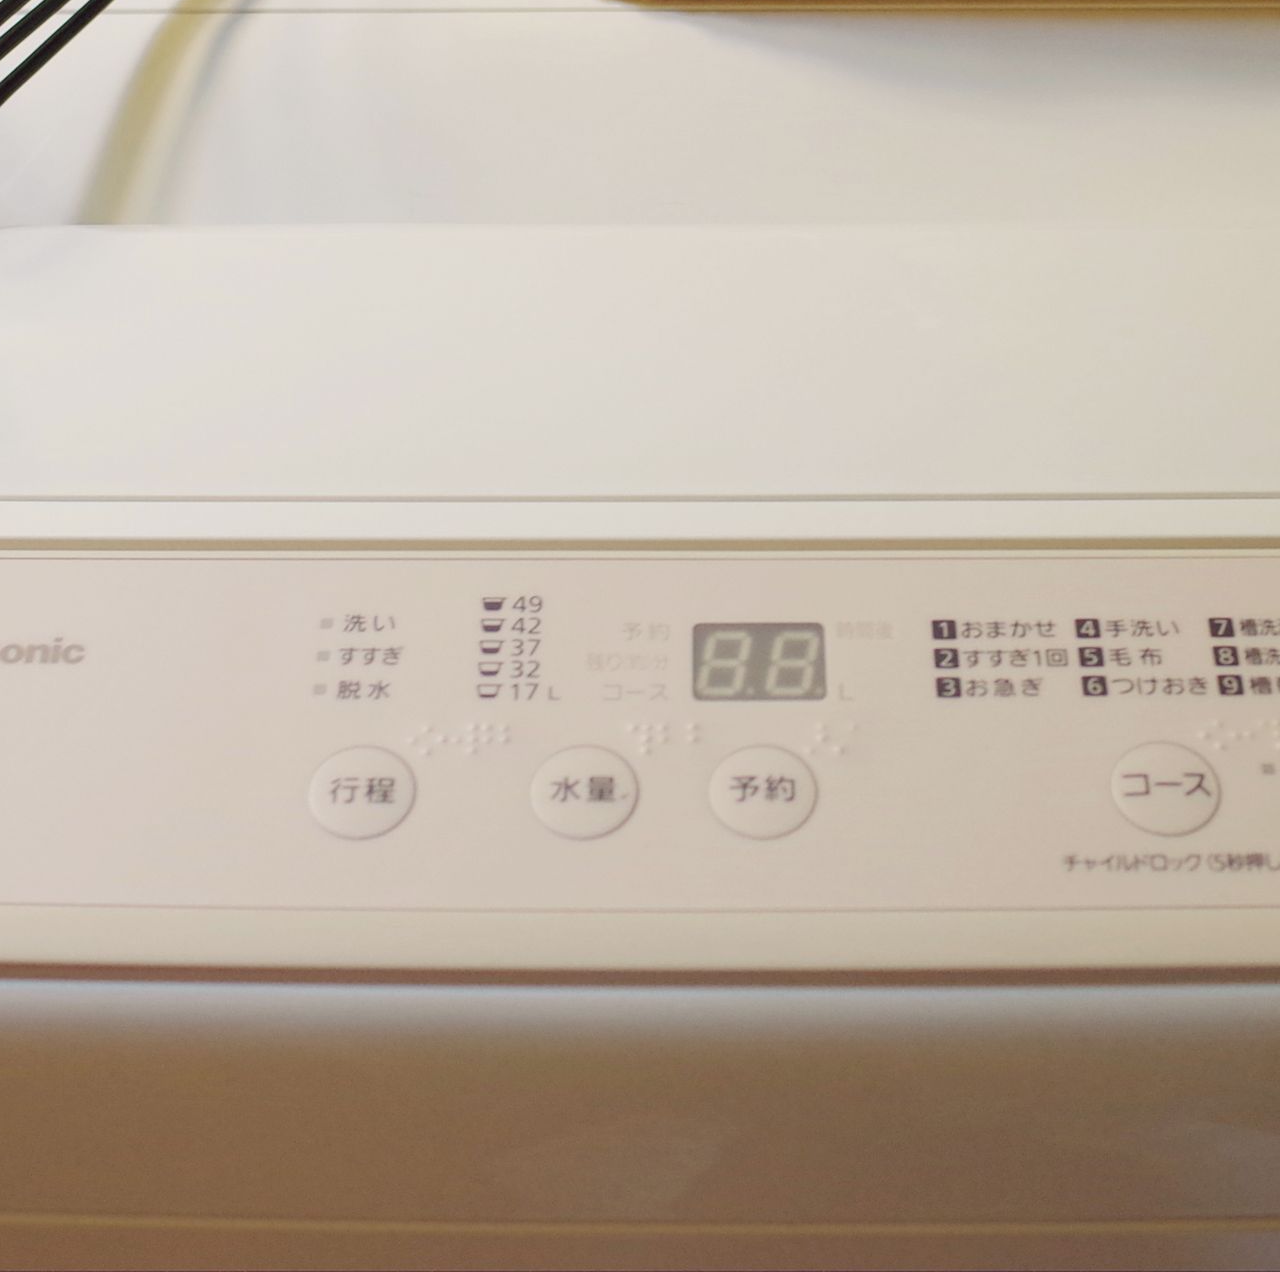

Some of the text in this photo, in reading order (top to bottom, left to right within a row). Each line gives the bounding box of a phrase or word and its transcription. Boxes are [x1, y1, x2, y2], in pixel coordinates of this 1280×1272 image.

[510, 594, 545, 615] 49
[342, 613, 397, 634] 洗い
[509, 615, 543, 636] 42
[960, 620, 1057, 640] おまかせ
[1105, 618, 1181, 639] 手洗い
[338, 645, 404, 667] すすぎ
[510, 637, 543, 658] 37
[1109, 647, 1164, 668] 毛布
[961, 648, 1070, 669] すすぎ1回
[509, 659, 542, 680] 32
[335, 679, 391, 701] 脱水
[509, 681, 541, 702] 17
[602, 681, 670, 703] コース
[965, 677, 1044, 698] お急ぎ
[1111, 675, 1208, 696] つけおき
[329, 775, 397, 806] 行程
[549, 775, 617, 804] 水量
[730, 775, 797, 805] 予約
[1122, 771, 1212, 798] コース
